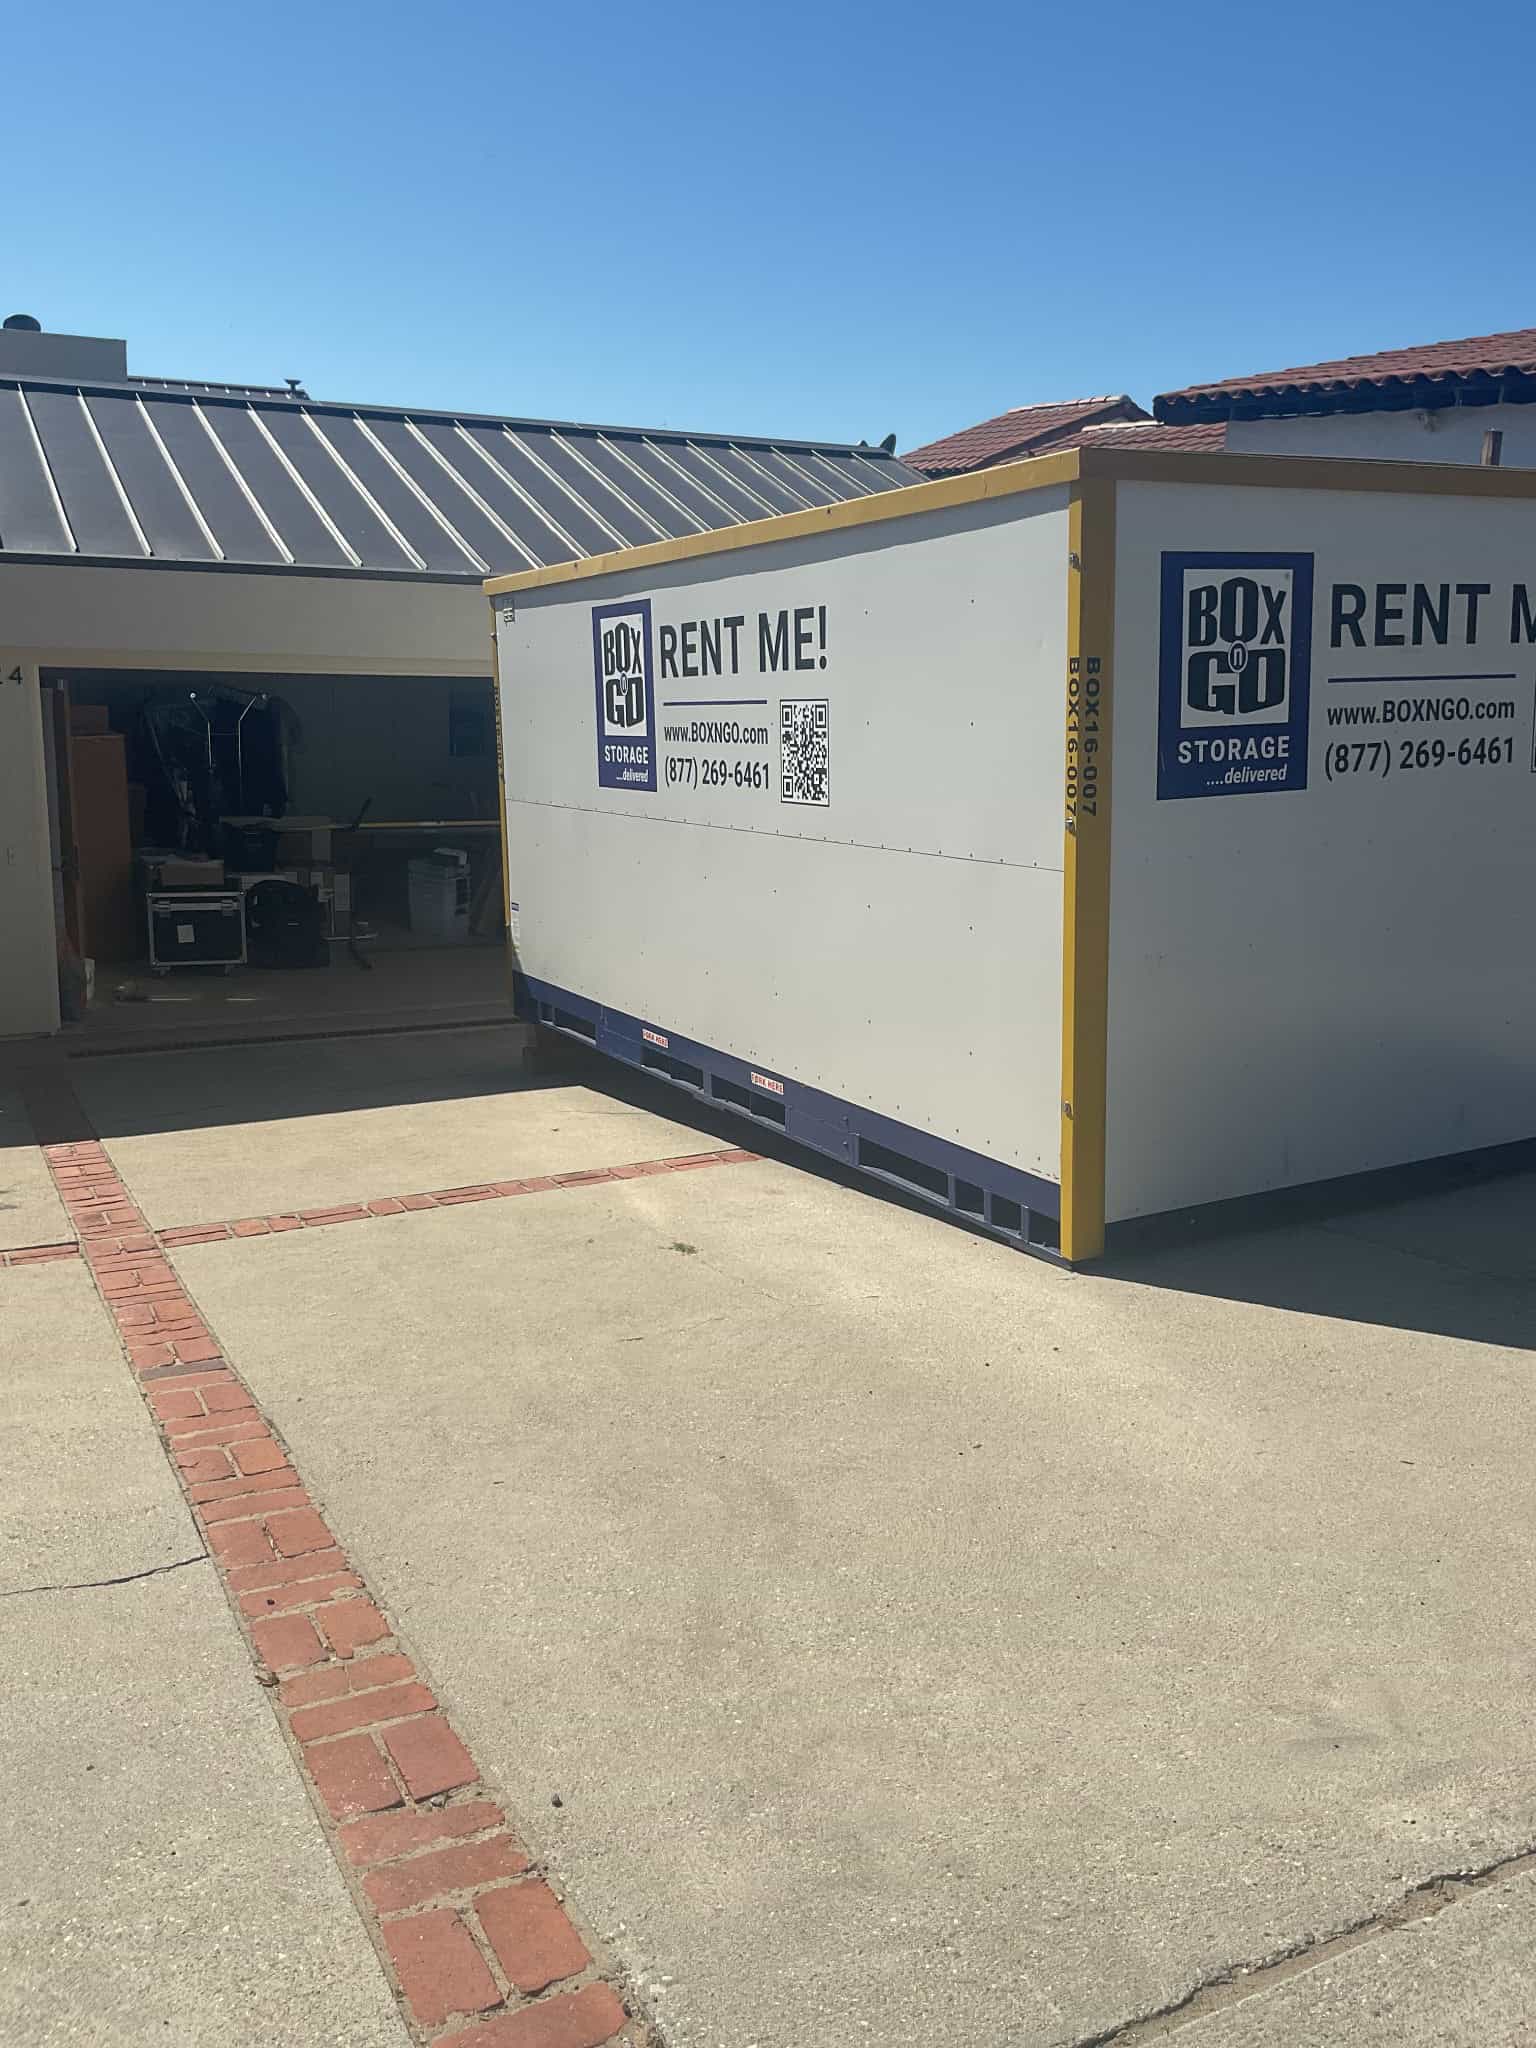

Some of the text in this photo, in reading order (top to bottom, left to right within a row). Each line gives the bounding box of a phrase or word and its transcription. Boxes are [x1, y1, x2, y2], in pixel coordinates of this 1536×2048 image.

[1188, 576, 1287, 647] BOX
[1330, 583, 1491, 648] RENT
[603, 622, 642, 676] BOX
[659, 605, 828, 679] RENT ME!
[605, 675, 645, 728] GO
[1187, 648, 1286, 715] GO
[664, 722, 768, 744] www.BOXNGO.com
[1066, 657, 1080, 816] BOX16-007
[1082, 657, 1101, 816] BOX16-007
[1327, 698, 1516, 726] www.BOXNGO.com
[605, 745, 649, 764] STORAGE
[665, 756, 769, 790] (877) 269-6461
[1178, 736, 1289, 764] STORAGE
[1325, 737, 1513, 781] (877) 269-6461
